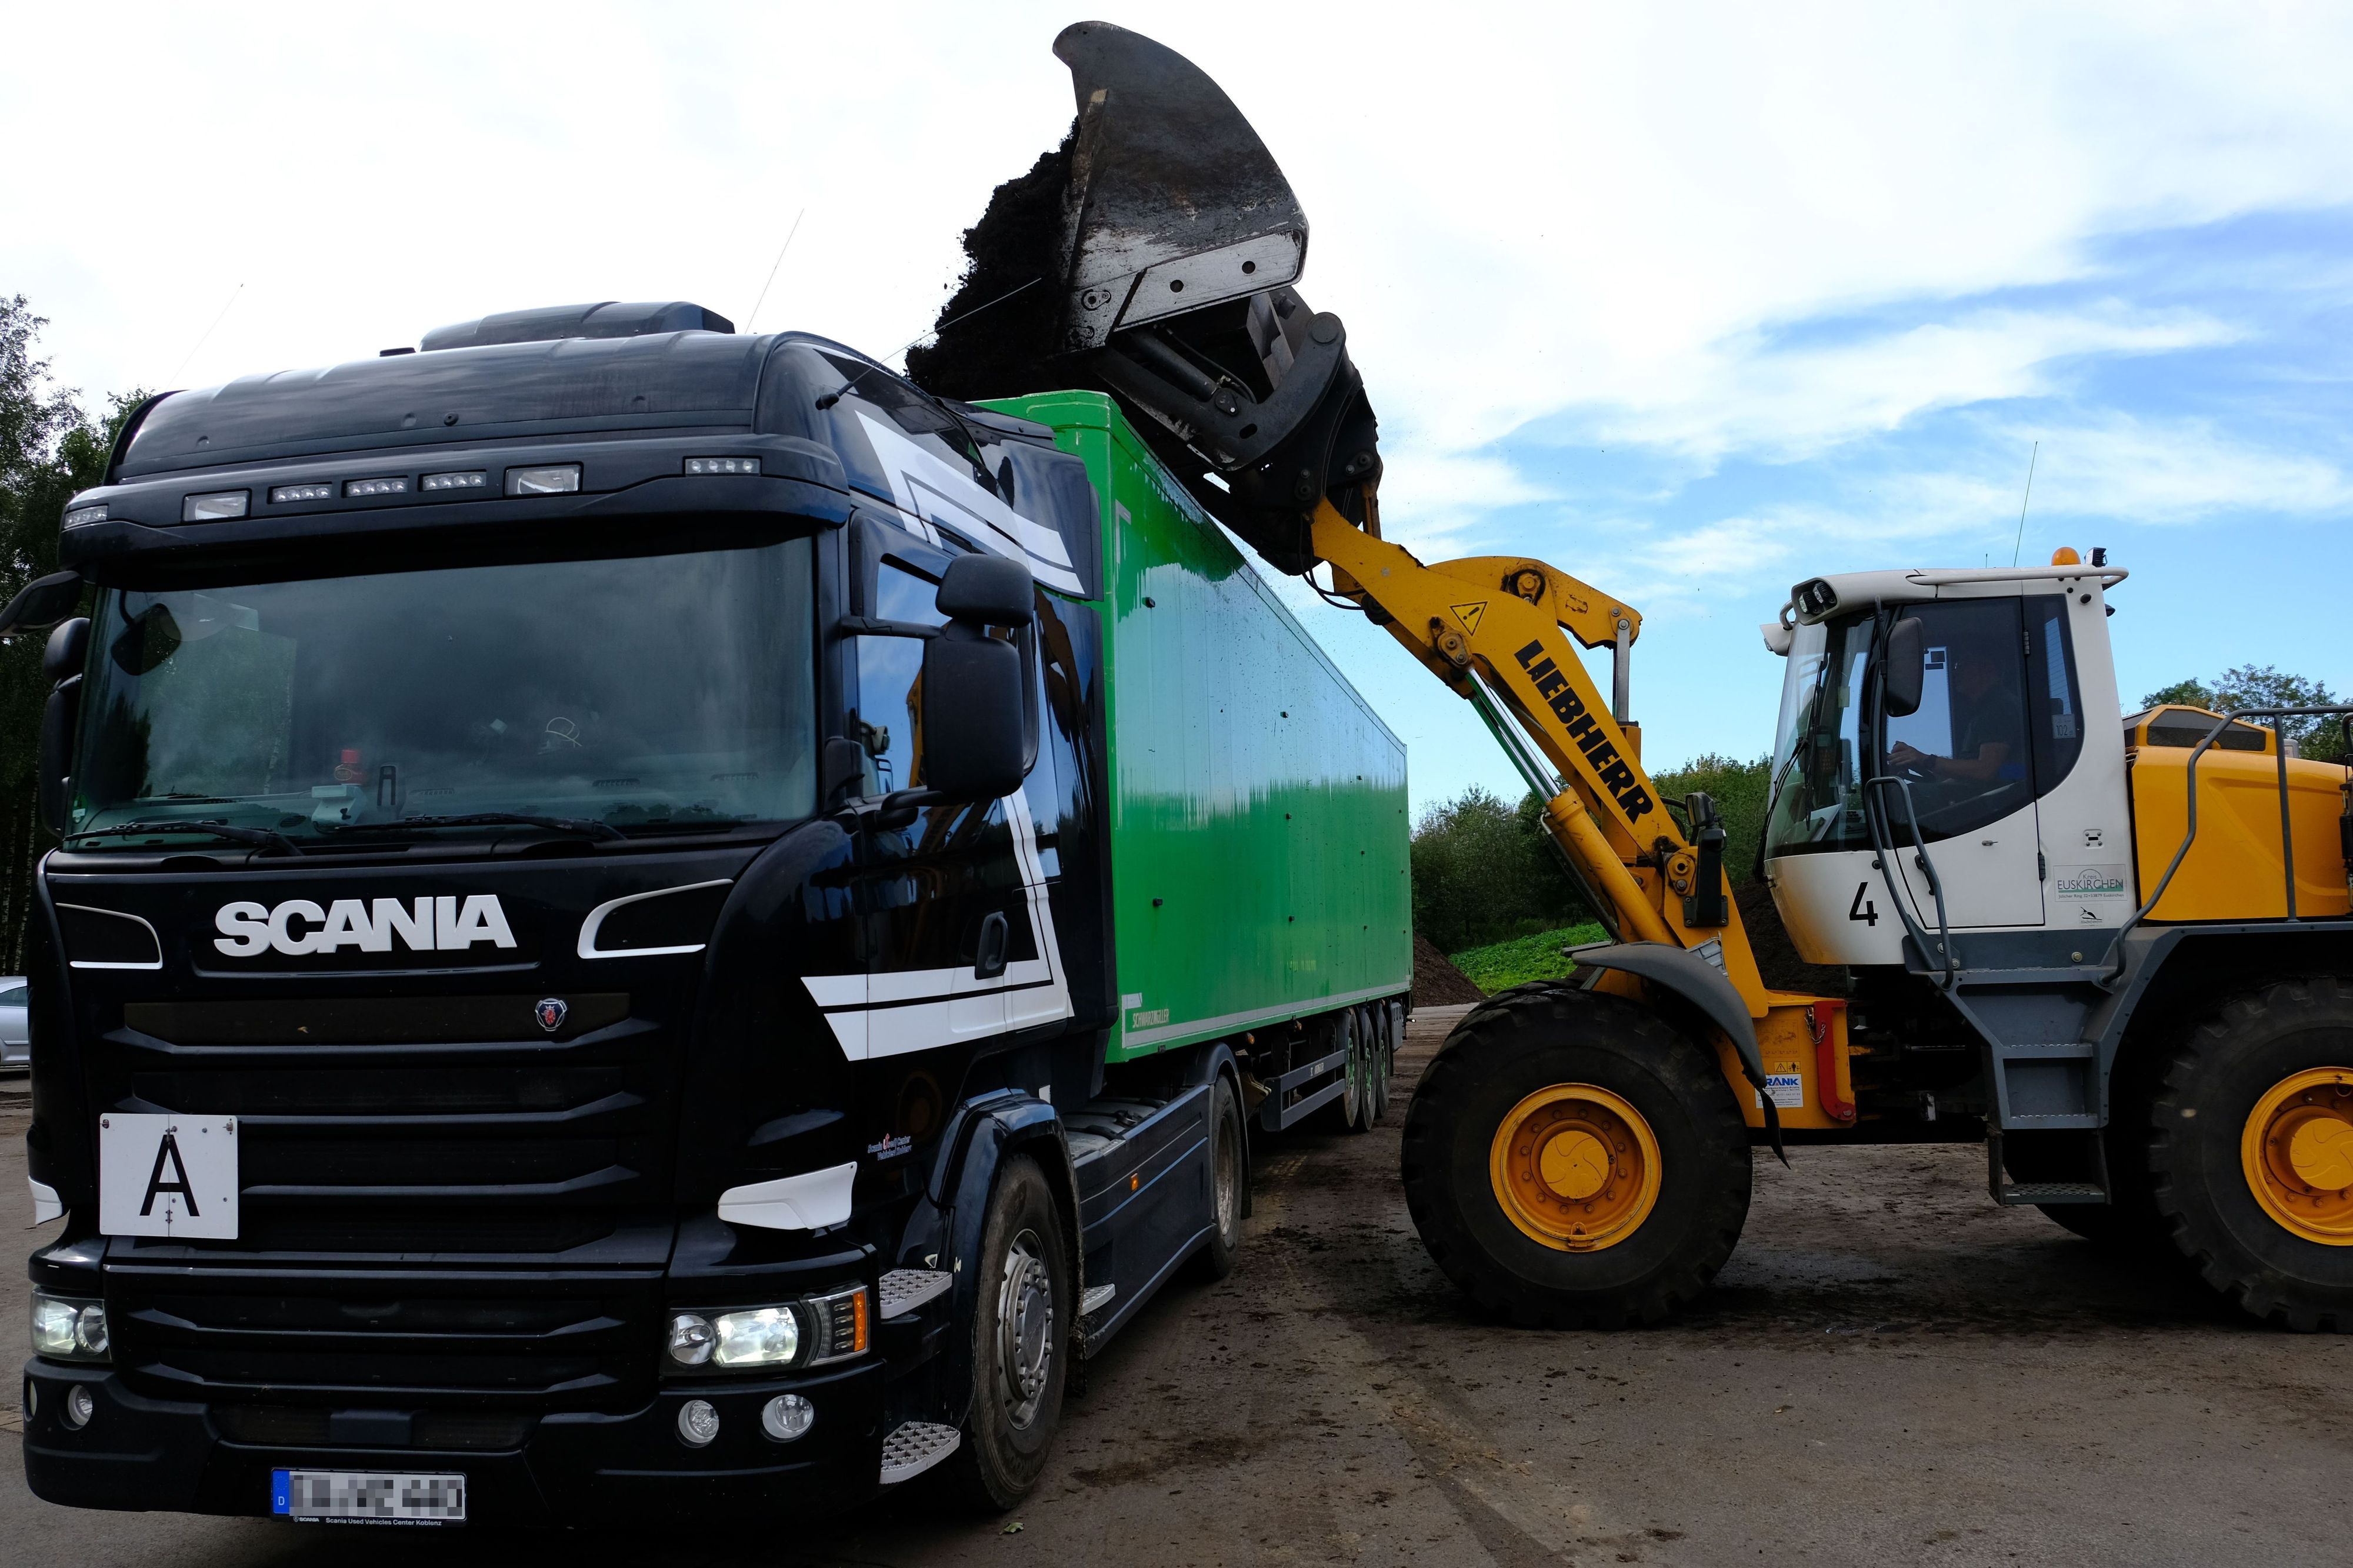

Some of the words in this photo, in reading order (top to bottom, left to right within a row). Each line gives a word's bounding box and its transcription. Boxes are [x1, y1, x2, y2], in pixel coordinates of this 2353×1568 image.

[1514, 639, 1654, 824] LIEBHERR
[2056, 725, 2068, 736] 102
[2057, 879, 2124, 889] EUSKIRCHEN
[1848, 882, 1878, 926] 4
[214, 894, 518, 957] SCANIA
[1767, 1077, 1798, 1086] RANK
[139, 1134, 201, 1217] A
[278, 1496, 285, 1506] D
